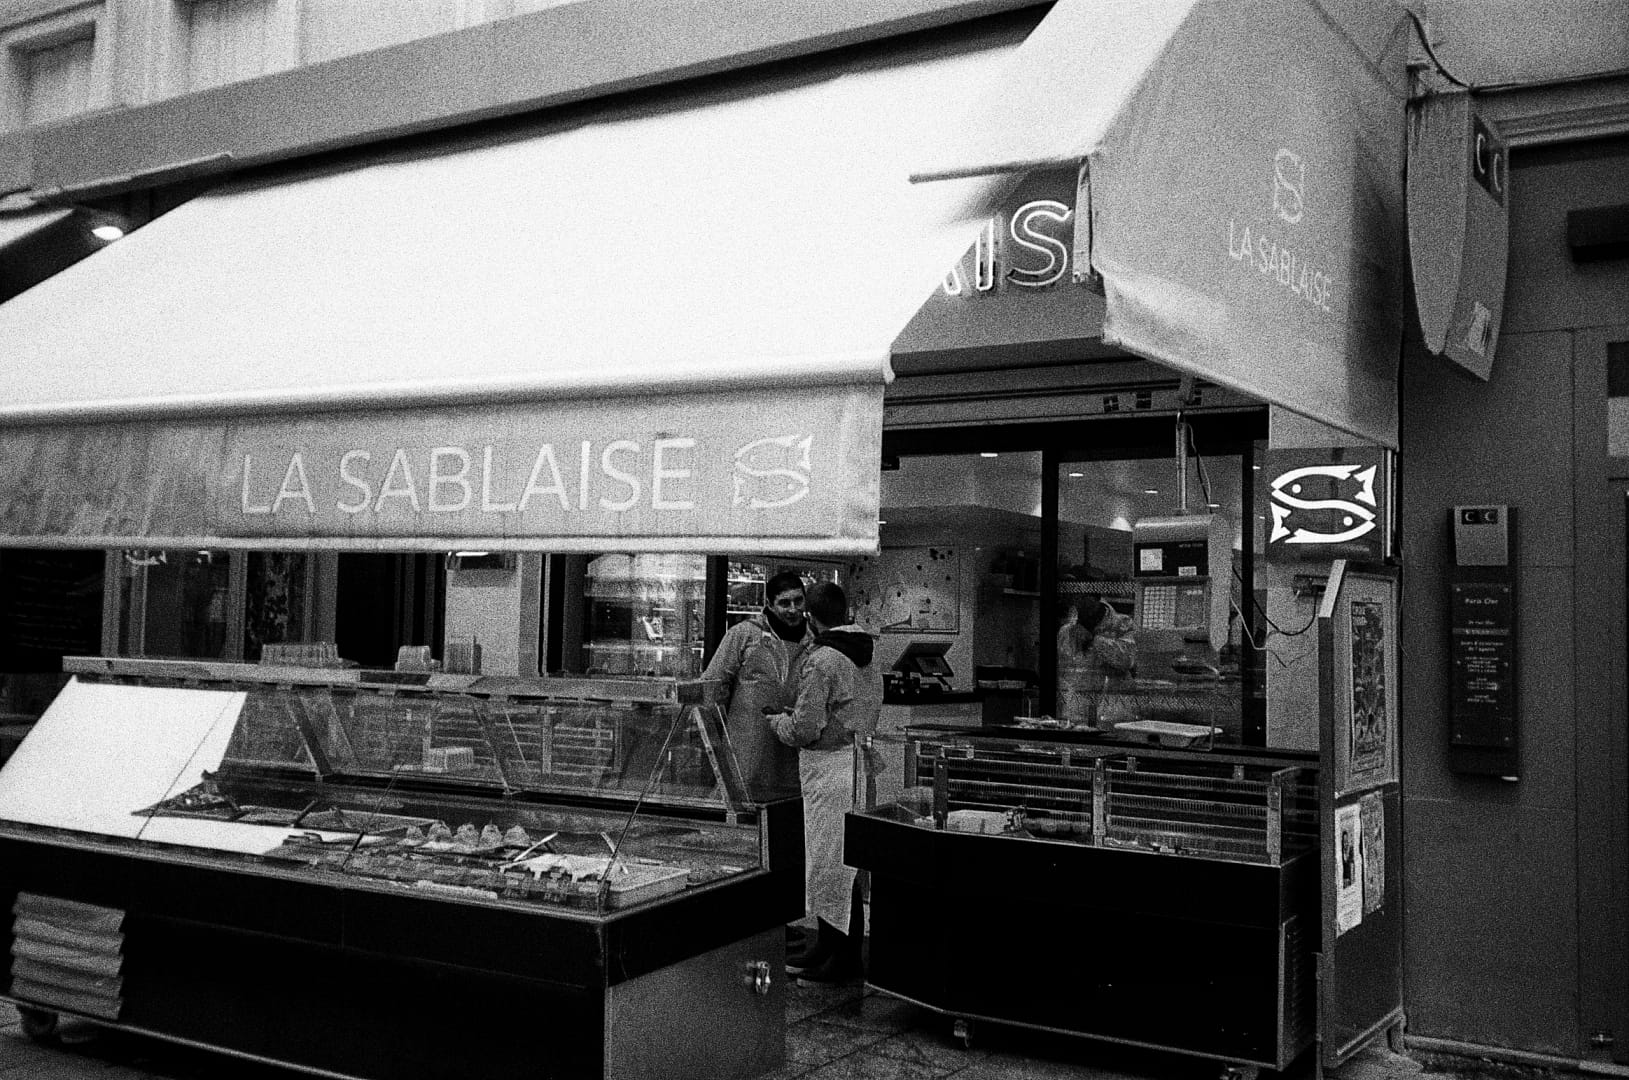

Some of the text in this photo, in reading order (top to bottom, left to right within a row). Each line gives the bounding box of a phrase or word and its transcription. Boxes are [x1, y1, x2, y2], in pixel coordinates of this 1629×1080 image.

[1229, 219, 1331, 313] LA SABLAISE
[243, 437, 695, 514] LA SABLAISE
